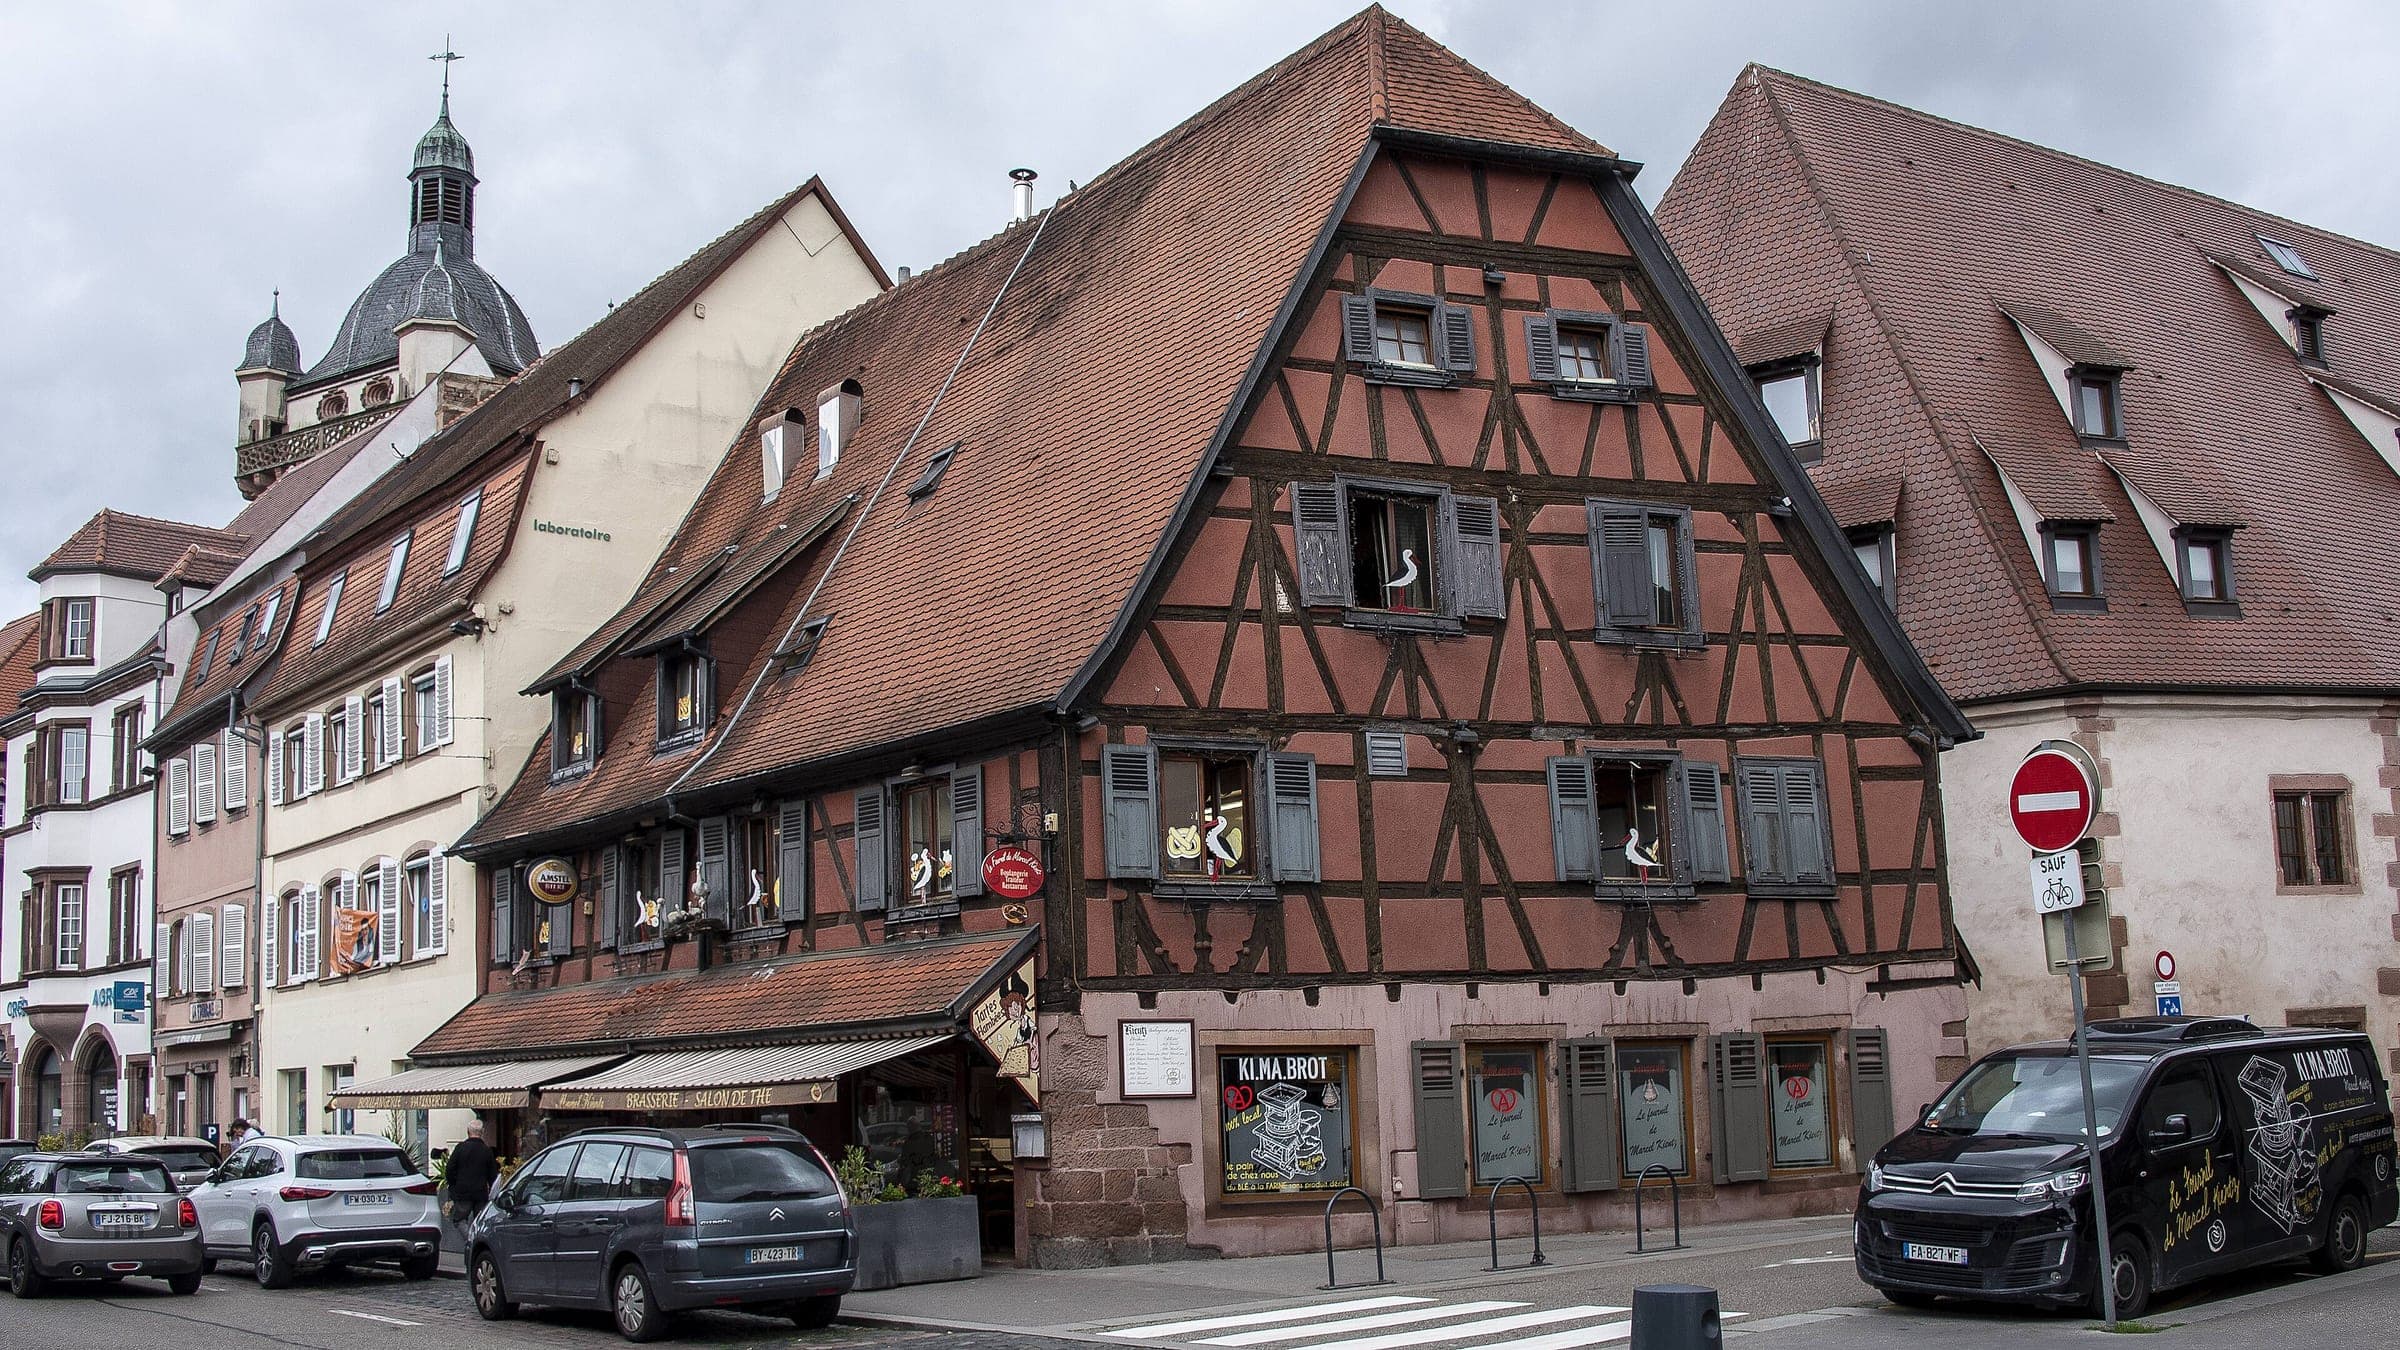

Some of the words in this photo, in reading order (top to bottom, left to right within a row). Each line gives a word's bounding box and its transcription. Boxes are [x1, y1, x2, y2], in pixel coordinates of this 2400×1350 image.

[534, 519, 612, 542] laboratoire
[2040, 856, 2066, 873] SAUF
[540, 873, 570, 883] AMSTEL
[92, 987, 113, 1007] AGR
[974, 999, 997, 1022] Tartes
[1239, 1056, 1328, 1081] KI.MA.BROT
[2292, 1047, 2354, 1081] KI.MA.BROT
[357, 1096, 402, 1109] BOULANGERIE
[411, 1094, 448, 1108] PATISSERIE
[458, 1092, 513, 1107] SANDWICHERIE
[626, 1092, 680, 1109] BRASSERIE
[694, 1089, 730, 1107] SALON
[731, 1089, 747, 1106] DE
[1784, 1101, 1793, 1112] Le
[1242, 1105, 1263, 1124] local
[1487, 1115, 1498, 1127] Le
[1635, 1109, 1646, 1121] Le
[1796, 1116, 1804, 1126] de
[207, 1126, 217, 1140] P
[1502, 1130, 1511, 1141] de
[1649, 1124, 1658, 1135] de
[1779, 1133, 1802, 1147] Marcel
[1481, 1147, 1507, 1163] Marcel
[1629, 1142, 1655, 1156] Marcel
[1226, 1162, 1235, 1171] le
[1235, 1162, 1254, 1172] pain
[1227, 1171, 1238, 1180] de
[1240, 1171, 1259, 1180] chez
[1260, 1171, 1280, 1180] nous
[1227, 1183, 1236, 1192] du
[1237, 1182, 1249, 1191] BLÉ
[2169, 1180, 2181, 1213] Le
[2163, 1223, 2175, 1252] de
[2176, 1187, 2211, 1240] Marcel
